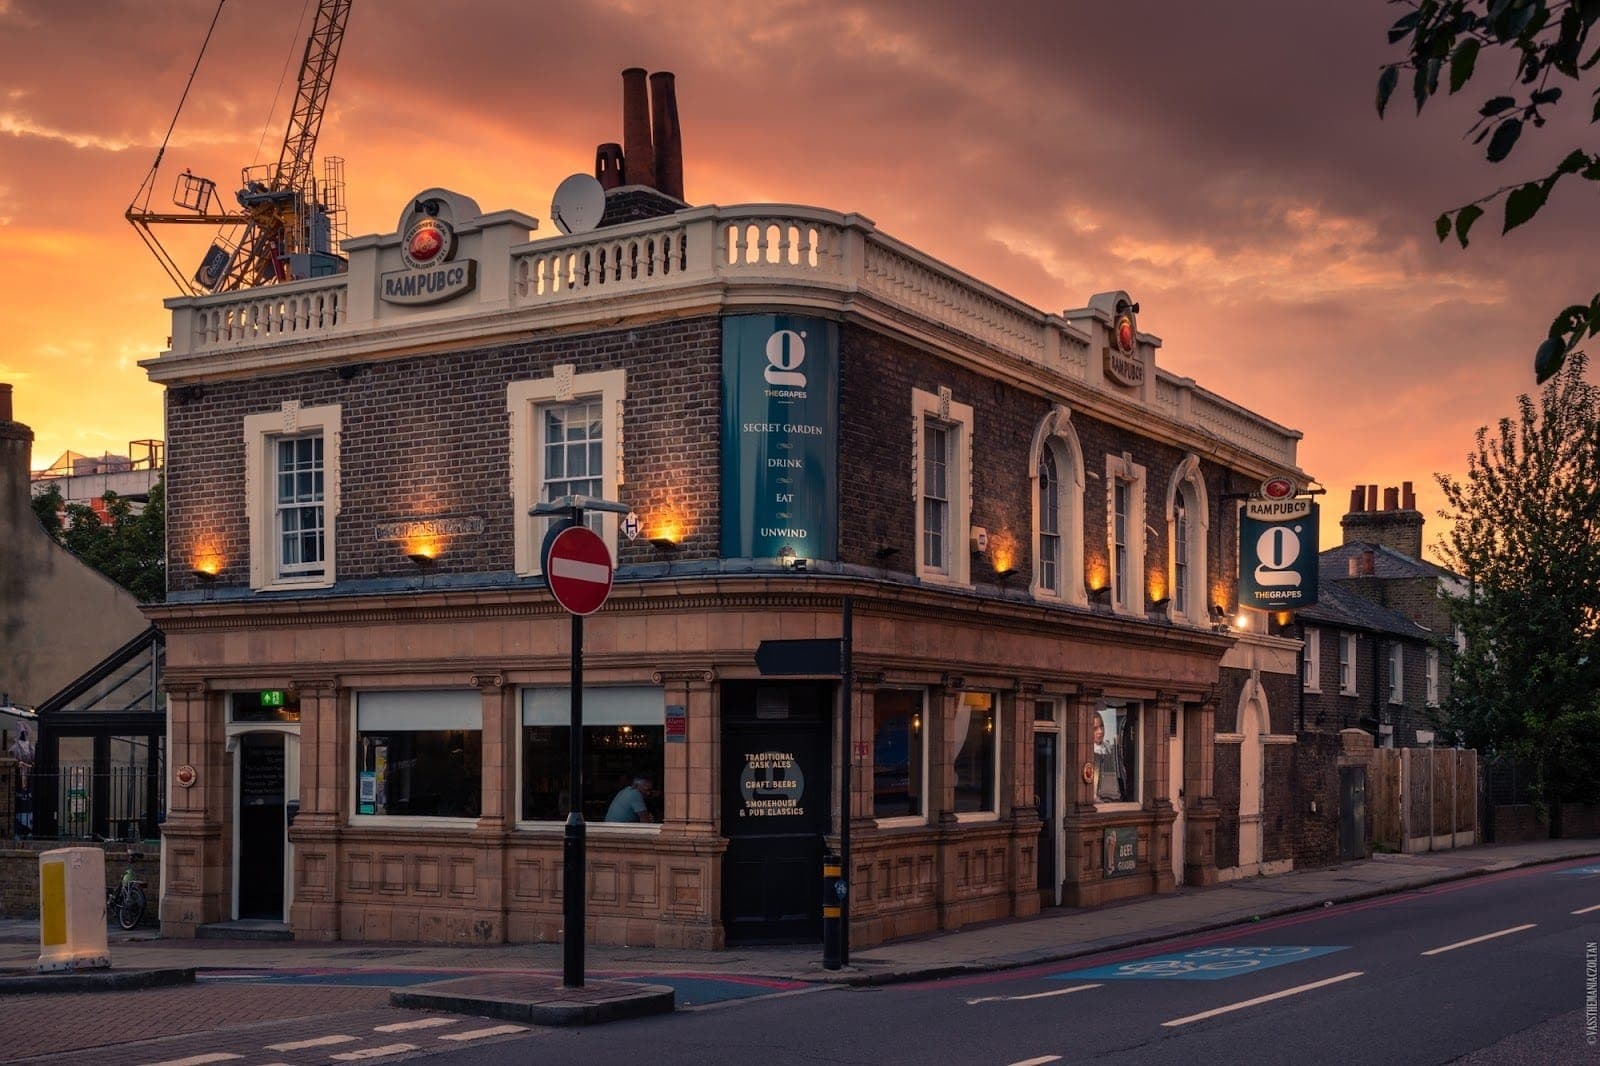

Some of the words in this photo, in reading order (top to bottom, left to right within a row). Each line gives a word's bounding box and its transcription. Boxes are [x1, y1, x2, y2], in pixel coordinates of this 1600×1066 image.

[764, 390, 807, 399] THEGRAPES
[743, 423, 781, 433] SECRET
[783, 423, 823, 435] GARDEN
[768, 458, 803, 468] DRINK
[776, 493, 794, 503] EAT
[626, 518, 638, 534] H
[760, 528, 807, 538] UNWIND
[1254, 590, 1302, 599] THEGRAPES
[745, 752, 794, 761] TRADITIONAL
[750, 761, 769, 769] CASK
[773, 760, 792, 768] ALES
[745, 781, 770, 789] CRAFT
[773, 780, 797, 788] BEERS
[745, 799, 797, 808] SMOKEHOUSE
[749, 808, 765, 817] PUB
[767, 807, 804, 816] CLASSICS
